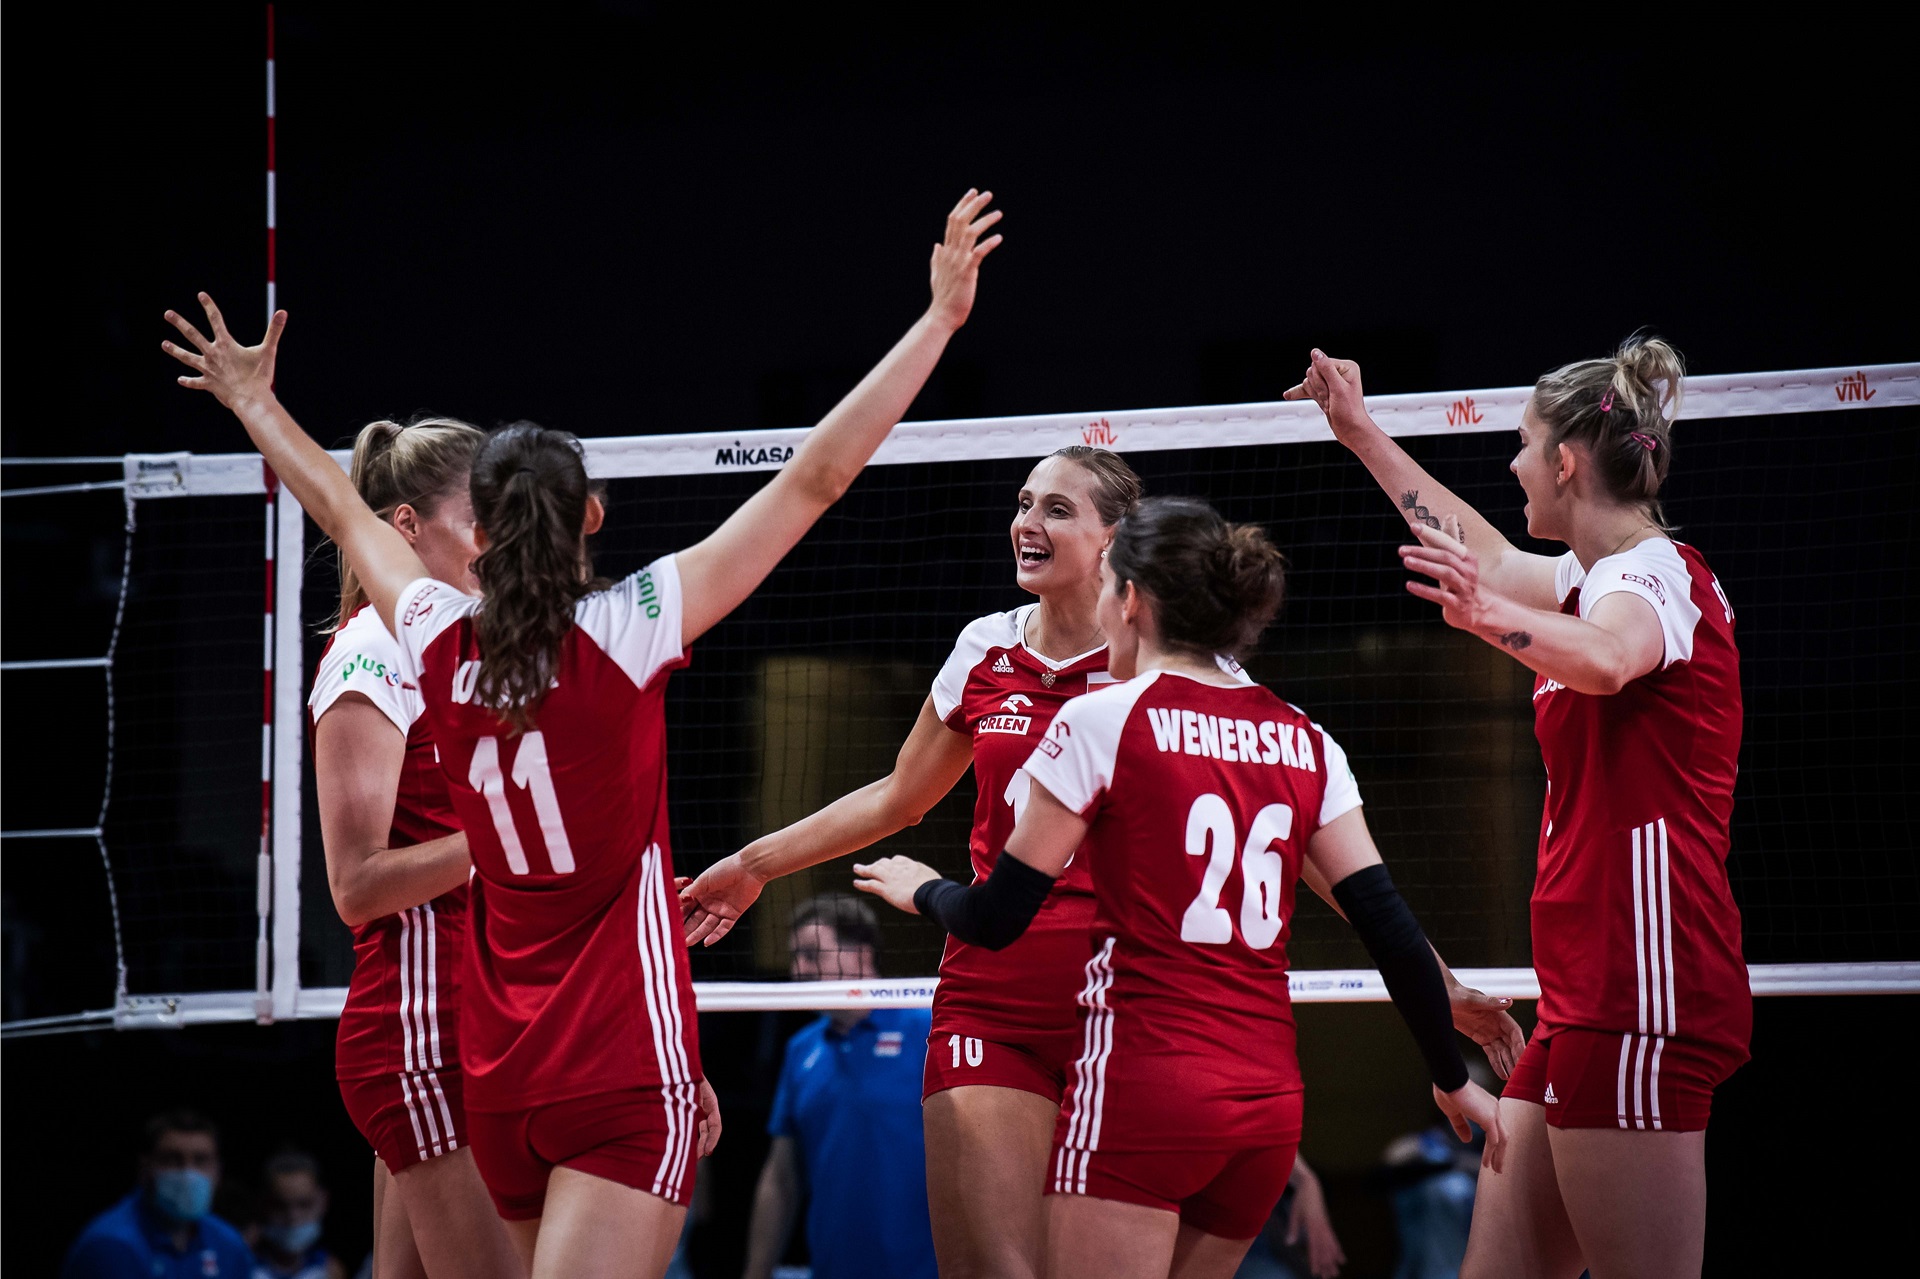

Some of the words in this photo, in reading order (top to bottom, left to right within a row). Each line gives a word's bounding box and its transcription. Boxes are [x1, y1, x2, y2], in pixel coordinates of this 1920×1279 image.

[342, 653, 386, 681] plus
[991, 664, 1015, 673] adidas
[979, 717, 1027, 732] ORLEN
[1146, 707, 1317, 772] WENERSKA
[468, 730, 576, 875] 11
[1180, 793, 1294, 950] 26
[948, 1034, 984, 1068] 10
